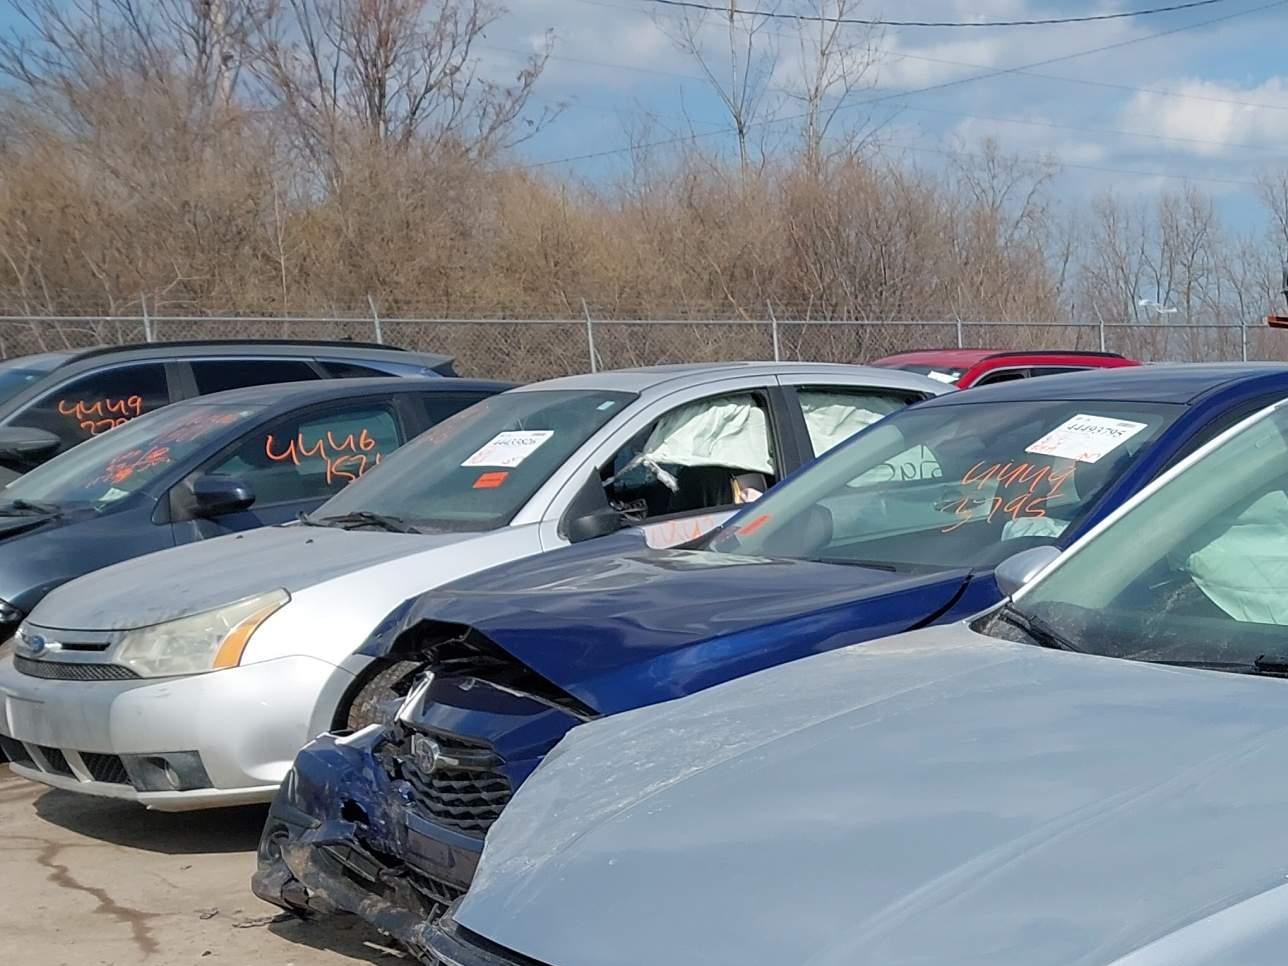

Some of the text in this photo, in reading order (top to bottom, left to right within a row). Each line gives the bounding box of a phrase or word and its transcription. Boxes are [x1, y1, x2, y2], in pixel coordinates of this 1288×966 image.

[58, 395, 144, 419] 4449
[266, 429, 376, 465] 4446
[961, 460, 1077, 497] 4449
